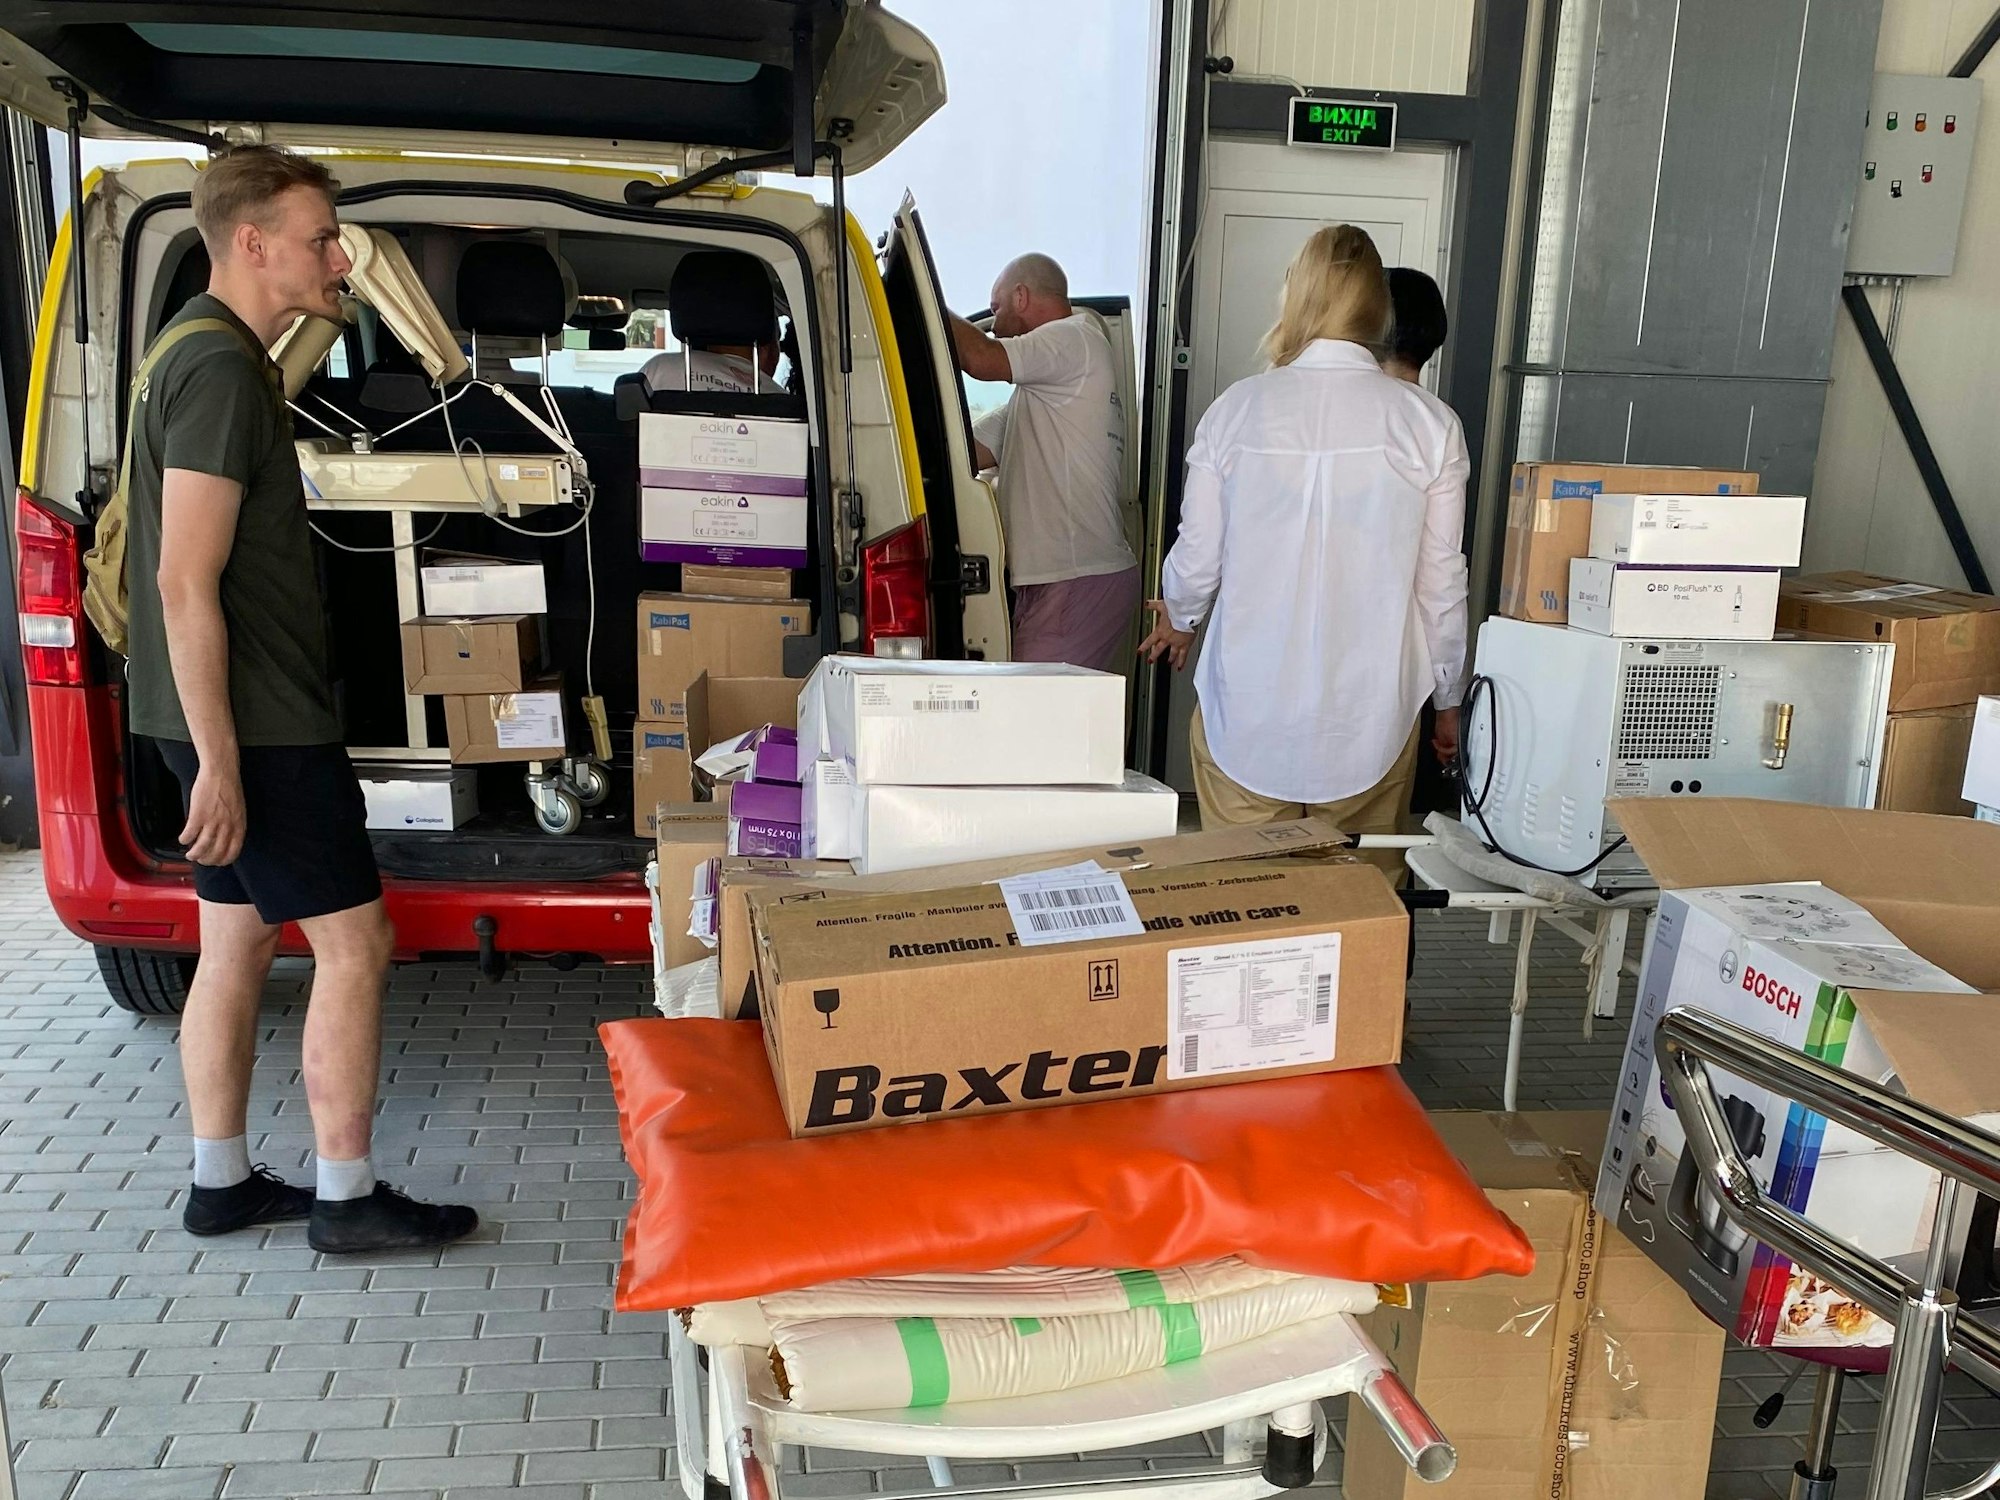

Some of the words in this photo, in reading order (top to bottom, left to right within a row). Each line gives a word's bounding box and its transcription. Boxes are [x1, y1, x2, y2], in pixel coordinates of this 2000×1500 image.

[1308, 105, 1377, 130] ВИХІД
[1322, 128, 1362, 143] EXIT
[700, 422, 734, 434] eakin
[701, 496, 735, 507] eakin
[1657, 584, 1669, 592] BD
[1713, 585, 1724, 593] XS
[652, 615, 689, 627] KabiPac
[646, 735, 682, 746] KabiPac
[748, 825, 766, 834] mm
[767, 828, 778, 838] 75
[1162, 881, 1207, 892] Vorsicht
[1217, 872, 1286, 886] Zerbrechlich
[875, 911, 916, 921] Fragile
[1189, 908, 1241, 926] with
[1246, 903, 1301, 920] care
[888, 935, 1001, 959] Attention.
[1742, 965, 1802, 1019] BOSCH
[804, 1044, 1167, 1129] Baxter
